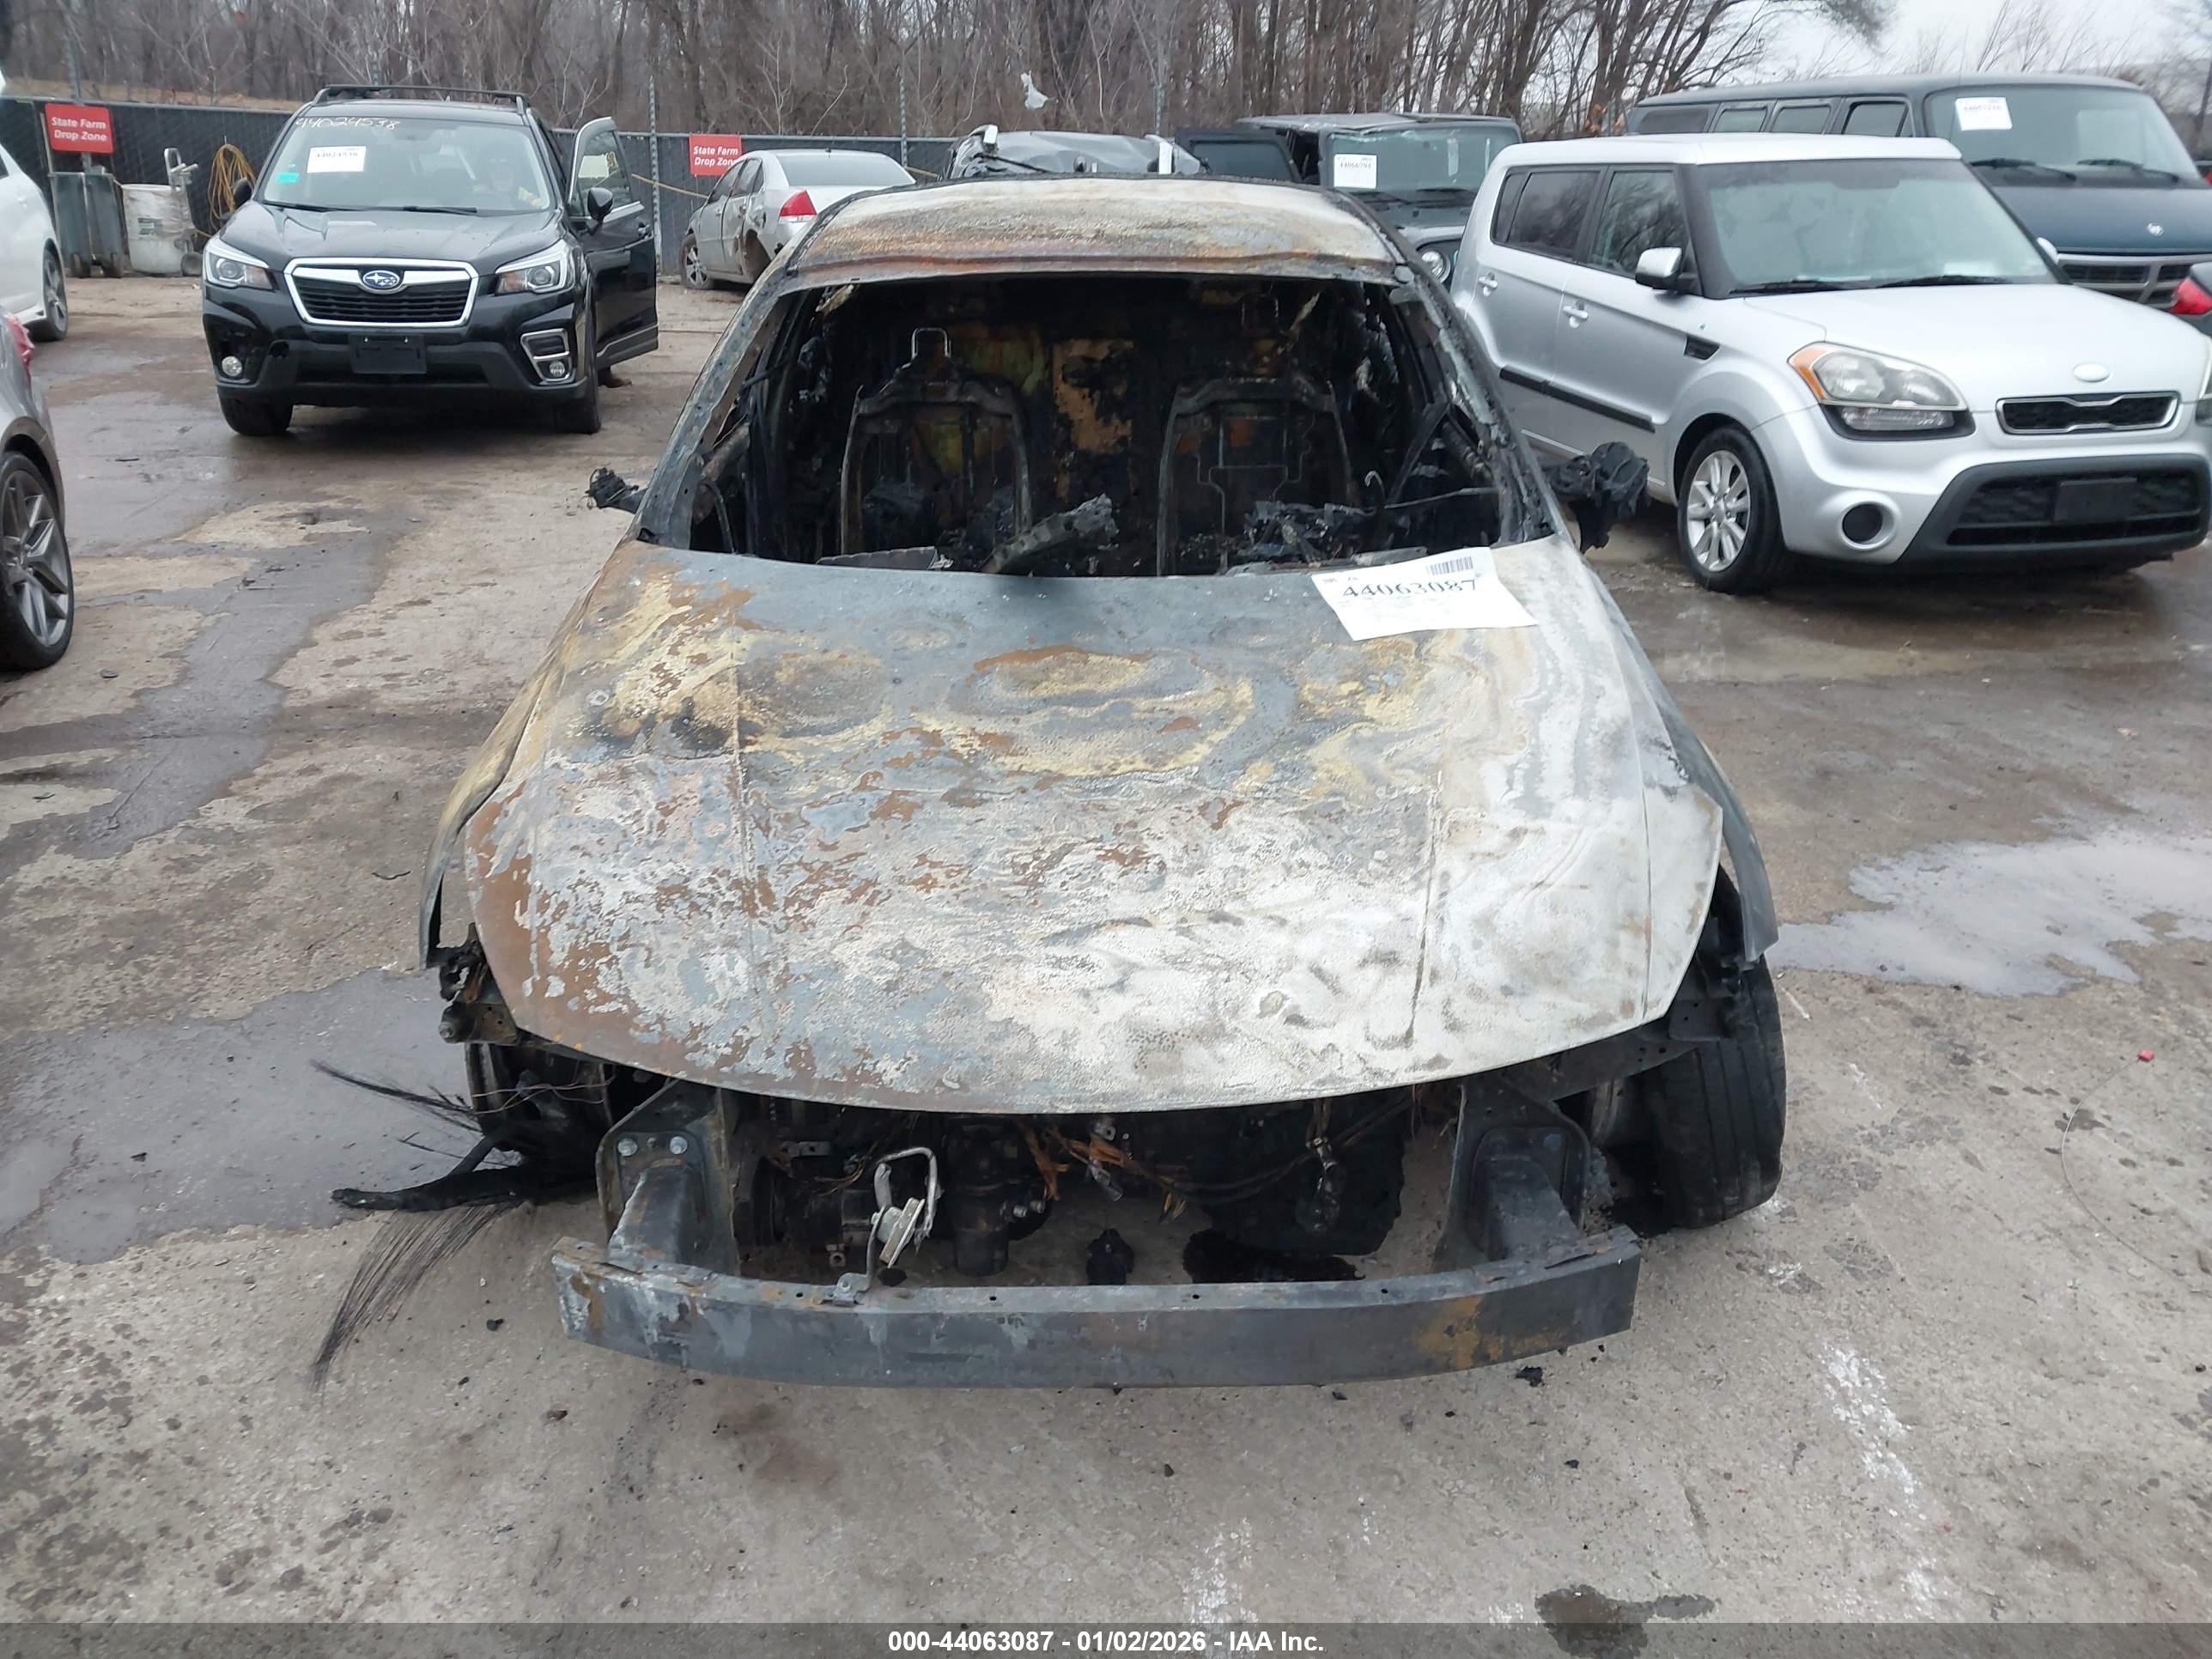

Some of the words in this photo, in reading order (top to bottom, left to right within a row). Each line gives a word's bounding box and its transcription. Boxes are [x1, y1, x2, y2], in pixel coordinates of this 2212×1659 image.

[52, 117, 77, 127] State
[81, 118, 106, 129] Farm
[54, 130, 79, 141] Drop
[82, 131, 107, 141] Zone
[693, 146, 715, 155] State
[718, 146, 738, 155] Farm
[694, 157, 715, 167] Drop
[1343, 579, 1476, 598] 44063087
